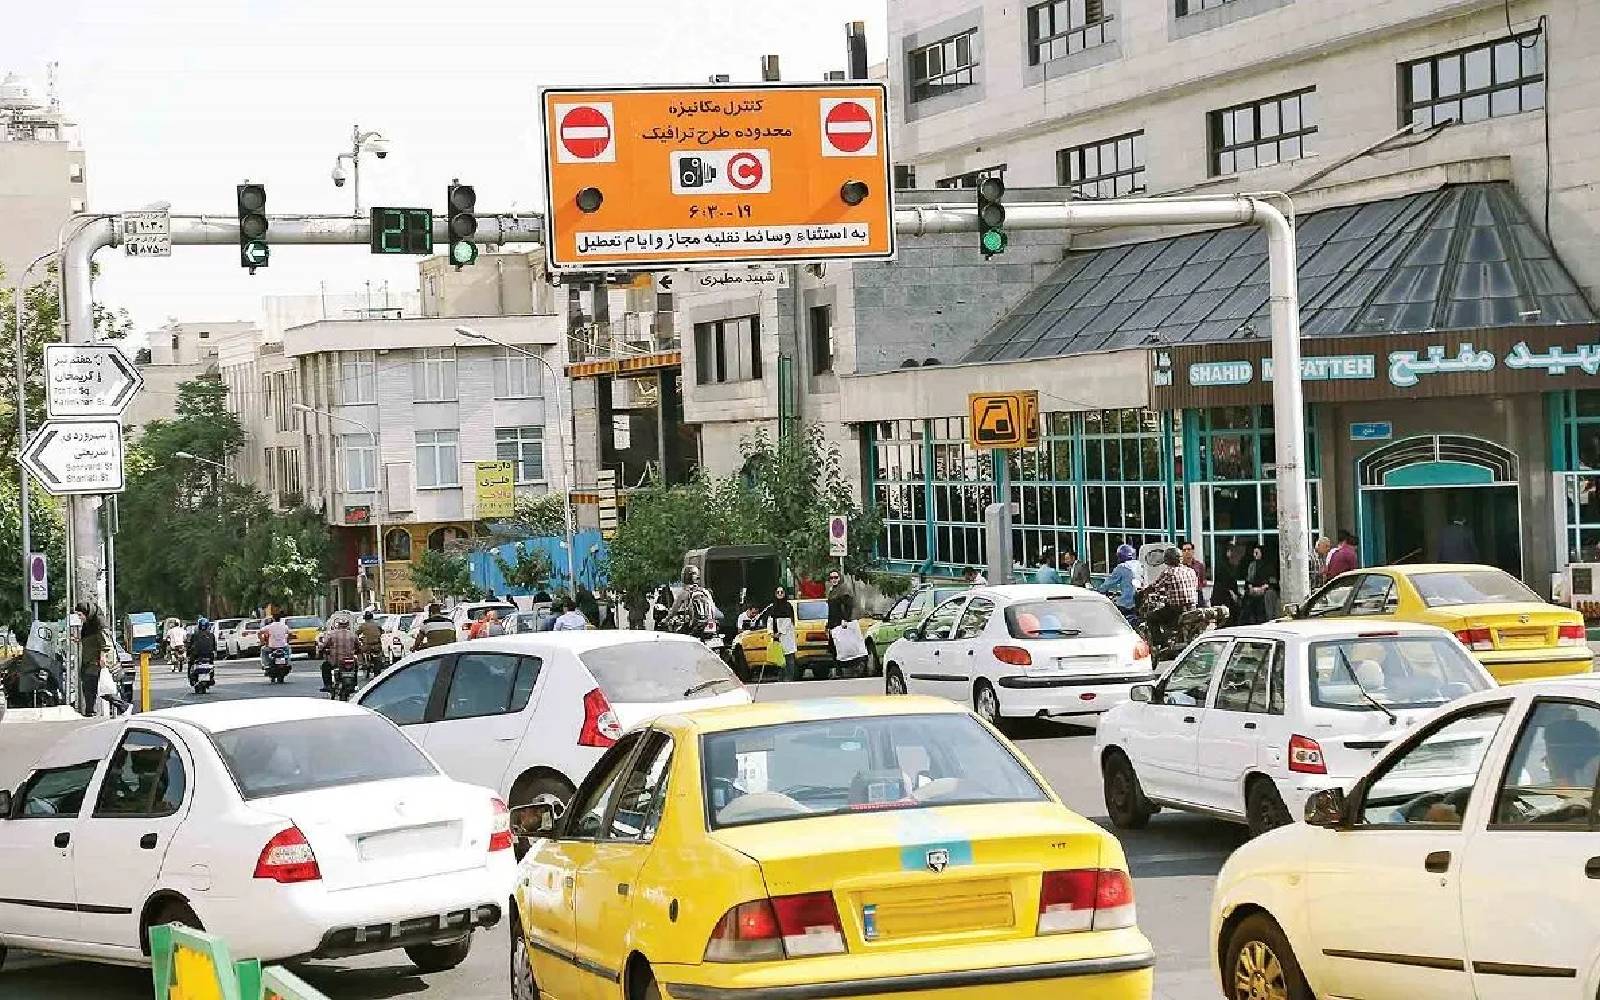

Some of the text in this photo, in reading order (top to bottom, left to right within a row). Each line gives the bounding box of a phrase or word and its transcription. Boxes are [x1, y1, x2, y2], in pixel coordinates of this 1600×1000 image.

[669, 100, 764, 117] کنترل مکانیزه
[642, 125, 792, 144] محدوده طرح ترافیک
[666, 232, 701, 249] مجاز
[704, 231, 740, 246] نقلیه
[851, 229, 866, 241] به
[578, 235, 621, 253] تعطیل
[700, 270, 776, 287] شهید مطهری
[1190, 364, 1251, 382] SHAHID
[1389, 343, 1496, 387] مفتح
